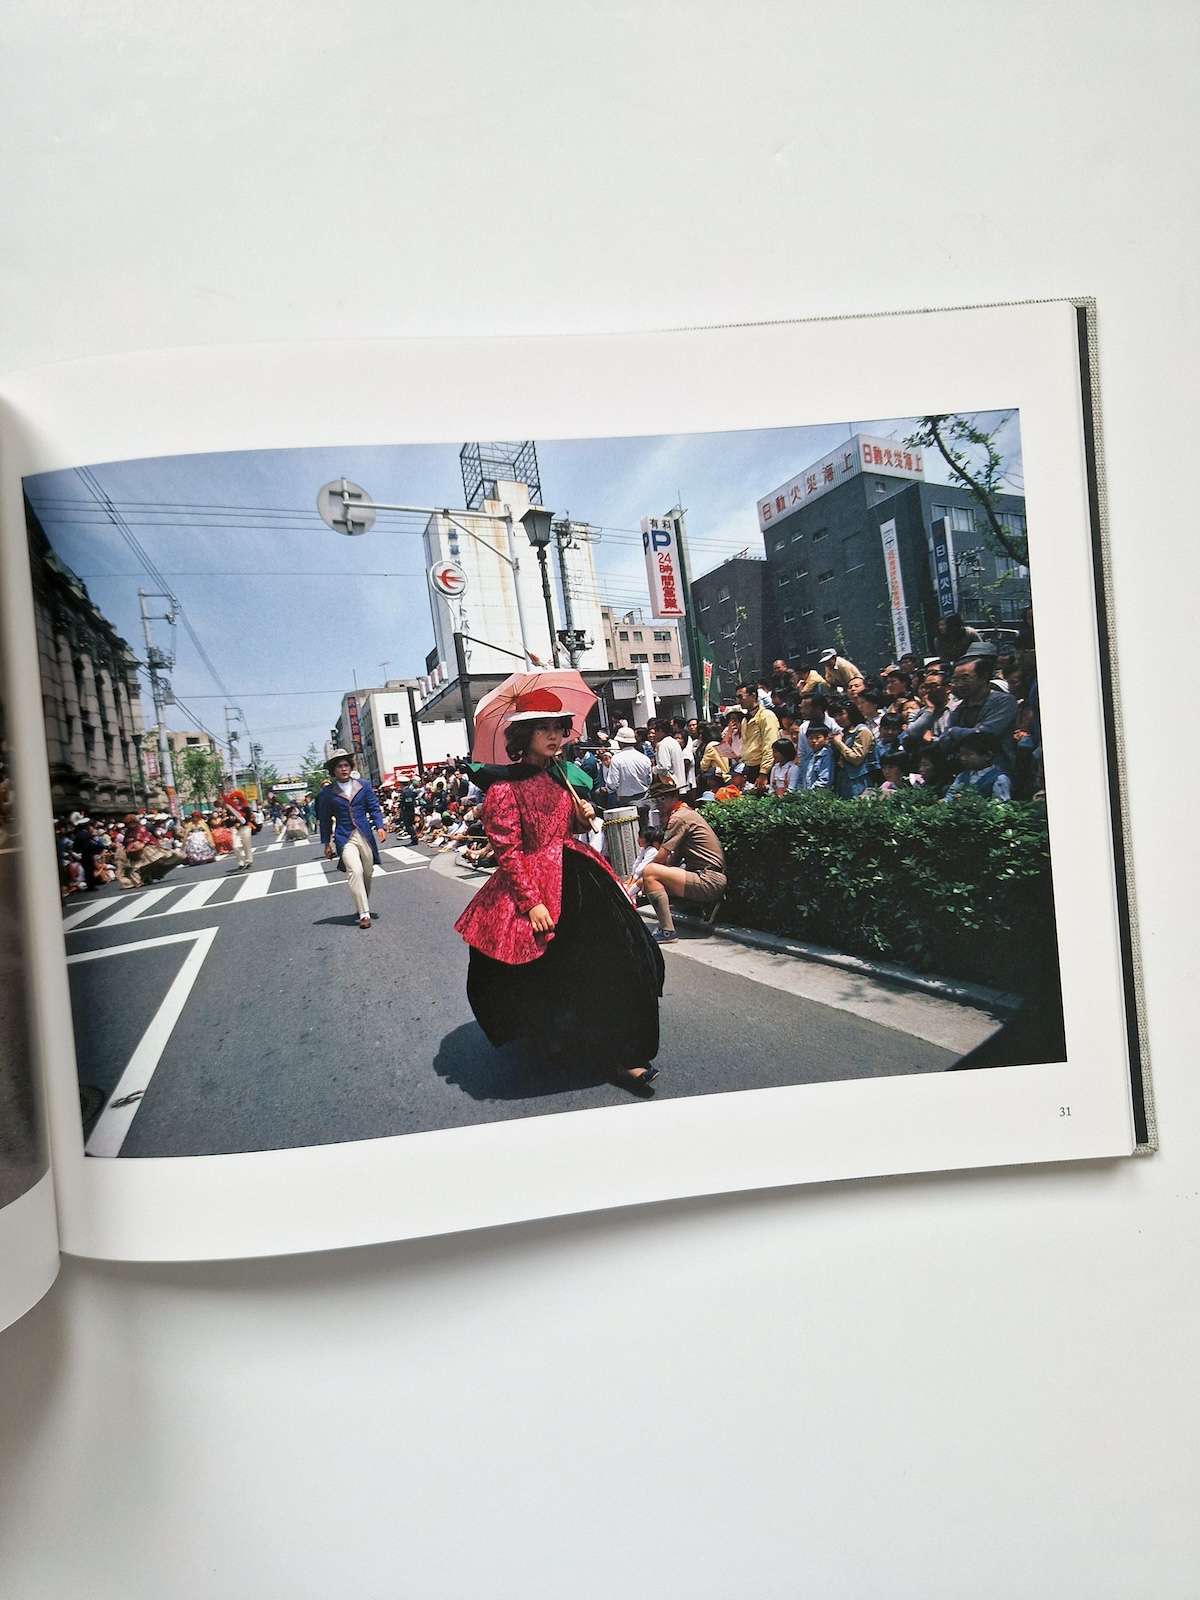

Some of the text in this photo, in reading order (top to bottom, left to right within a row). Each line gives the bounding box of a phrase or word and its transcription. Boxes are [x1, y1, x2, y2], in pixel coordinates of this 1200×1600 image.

[762, 452, 854, 521] 日動火災海上
[651, 530, 671, 552] P
[1059, 1106, 1071, 1117] 31
